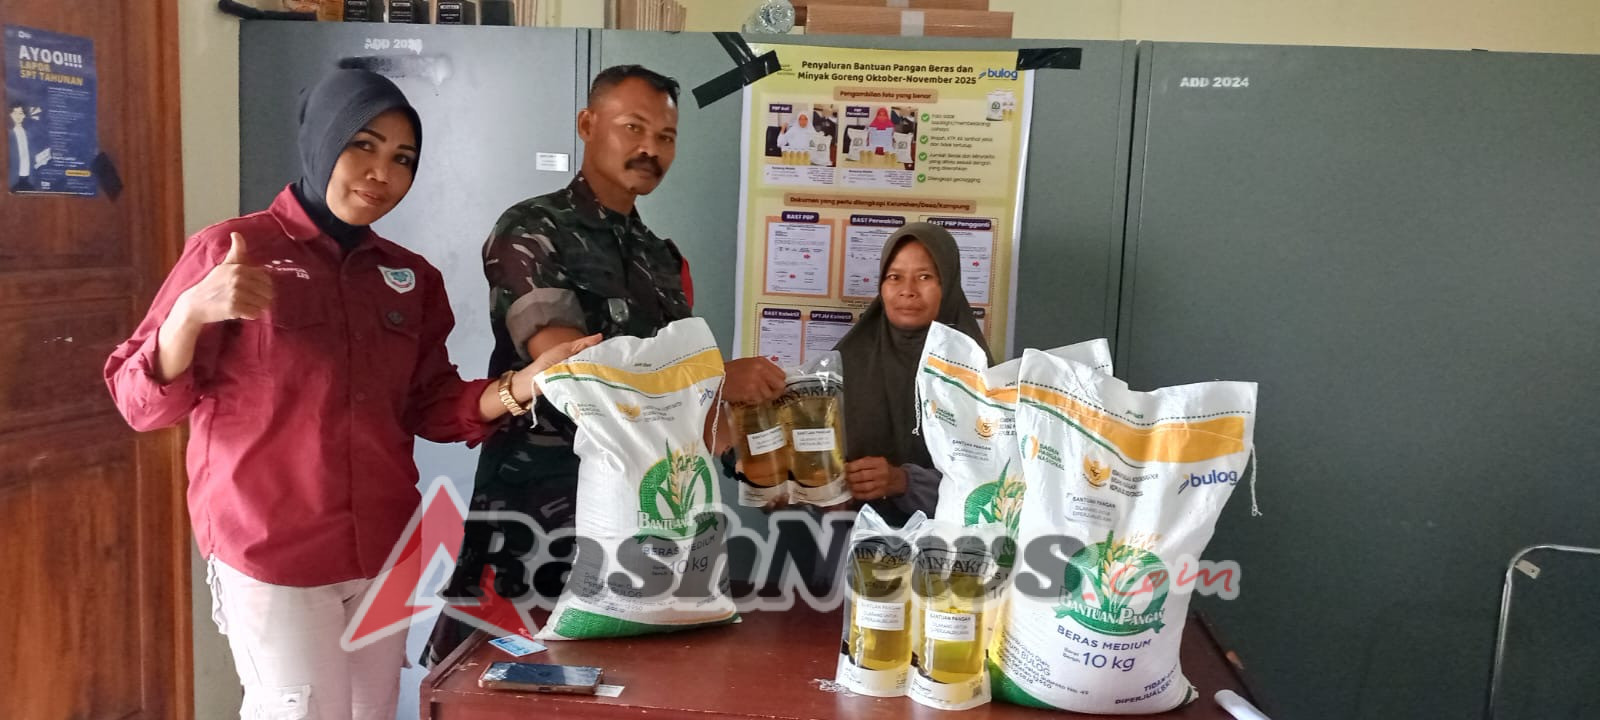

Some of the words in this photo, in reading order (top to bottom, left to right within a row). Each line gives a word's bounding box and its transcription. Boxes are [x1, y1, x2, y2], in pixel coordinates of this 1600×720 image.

[802, 61, 852, 70] Penyaluran
[853, 62, 891, 71] Bantuan
[893, 64, 926, 73] Pangan
[928, 64, 954, 73] Beras
[956, 65, 974, 73] dan
[20, 69, 37, 80] SPT
[39, 71, 84, 86] TAHUNAN
[798, 72, 829, 81] Minyak
[831, 73, 863, 83] Goreng
[865, 74, 952, 84] Oktober-November
[954, 76, 976, 85] 2025
[987, 68, 1018, 81] bulog
[1180, 77, 1209, 87] ADD
[1212, 77, 1249, 87] 2024
[840, 91, 881, 99] Pengambilan
[790, 196, 820, 204] Dokumen
[1038, 449, 1062, 463] PANGAN
[1039, 443, 1060, 456] BADAN
[1190, 469, 1238, 488] bulog
[692, 555, 709, 572] kg
[1059, 586, 1118, 624] BANTUAN
[1117, 607, 1166, 626] PANGAN
[1057, 624, 1099, 648] BERAS
[1102, 638, 1152, 651] MEDIUM
[1021, 650, 1051, 676] BULOG
[1082, 652, 1107, 668] 10
[1111, 655, 1135, 672] kg
